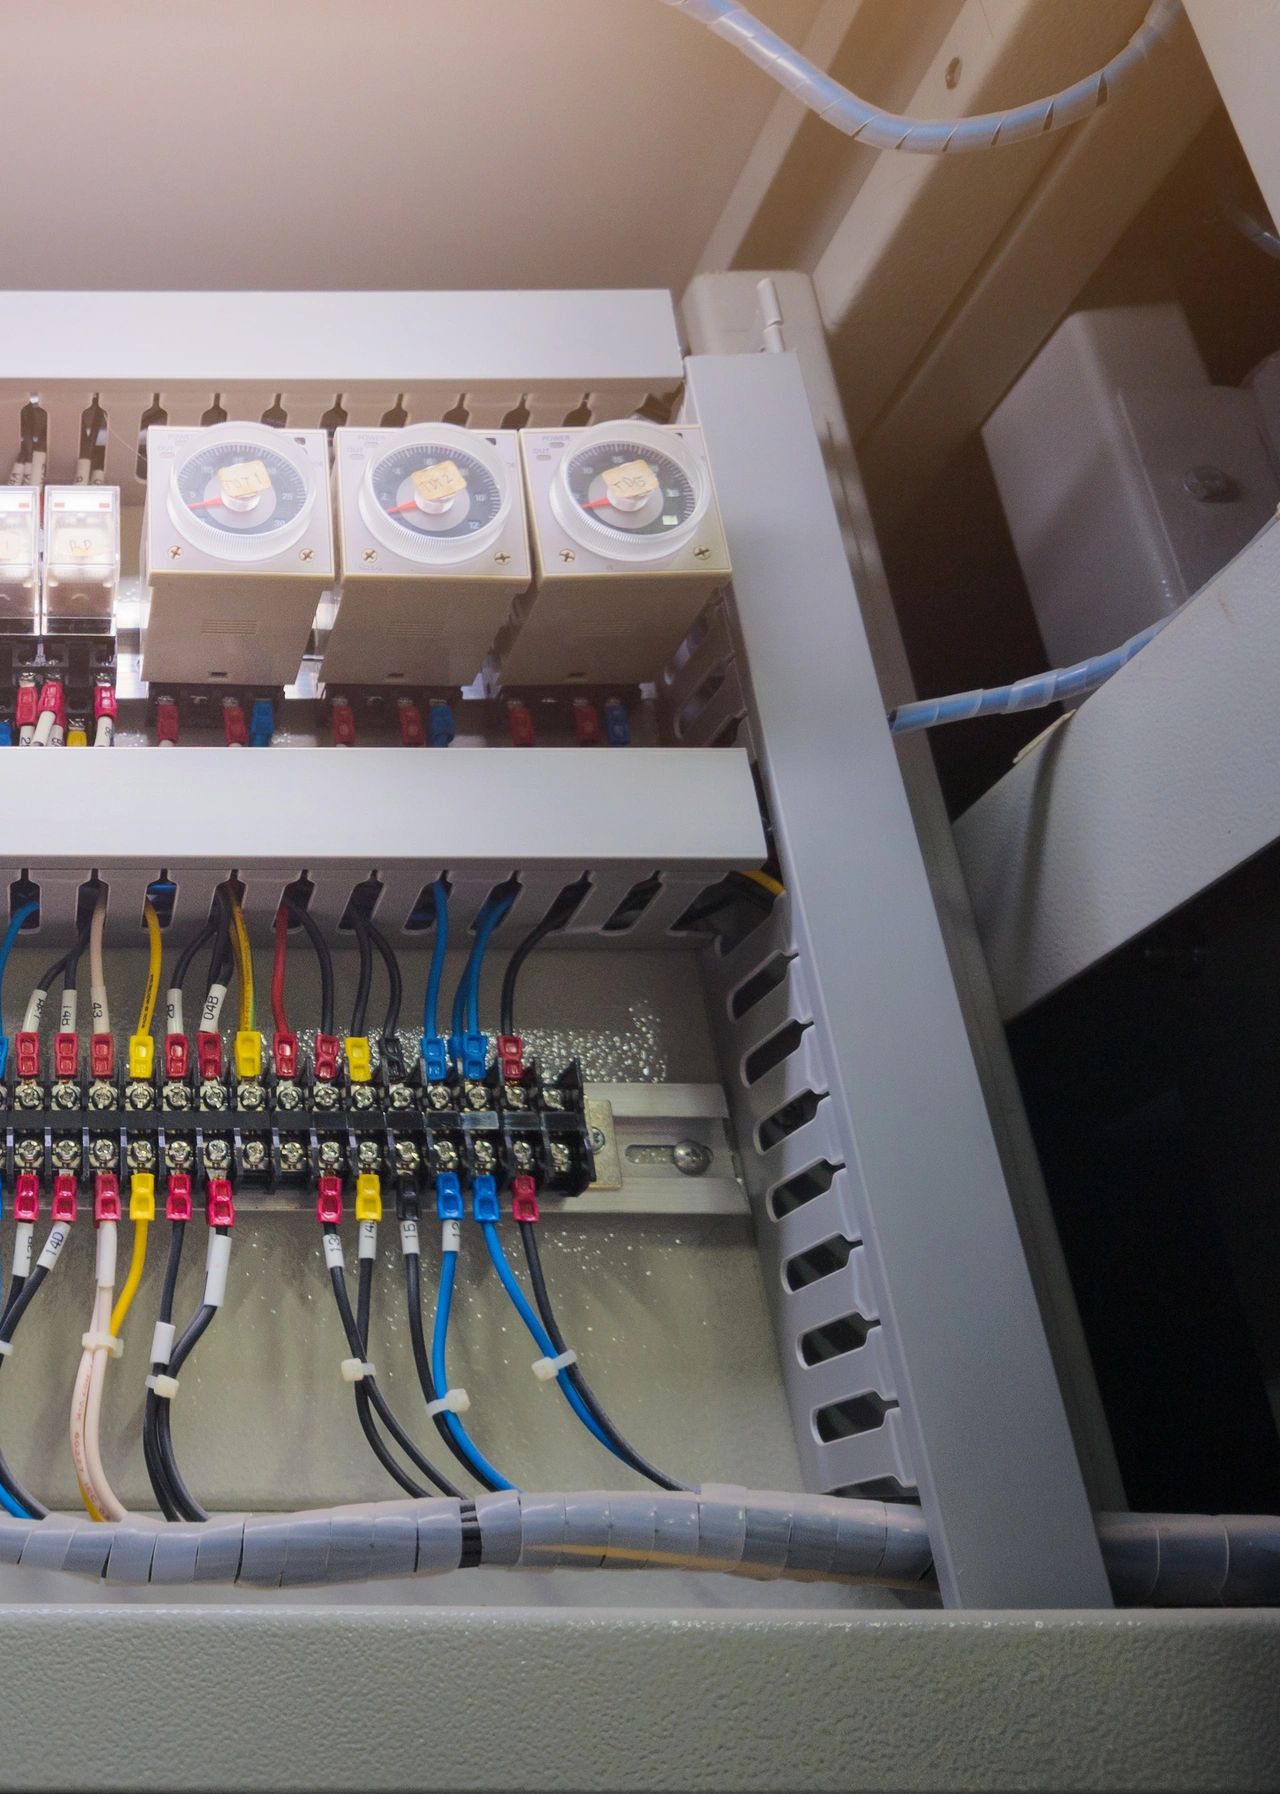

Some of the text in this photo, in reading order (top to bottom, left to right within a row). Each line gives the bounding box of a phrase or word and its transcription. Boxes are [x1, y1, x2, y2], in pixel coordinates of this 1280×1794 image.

[91, 1002, 103, 1018] 43
[204, 995, 220, 1021] 04B
[45, 1231, 64, 1256] 14D
